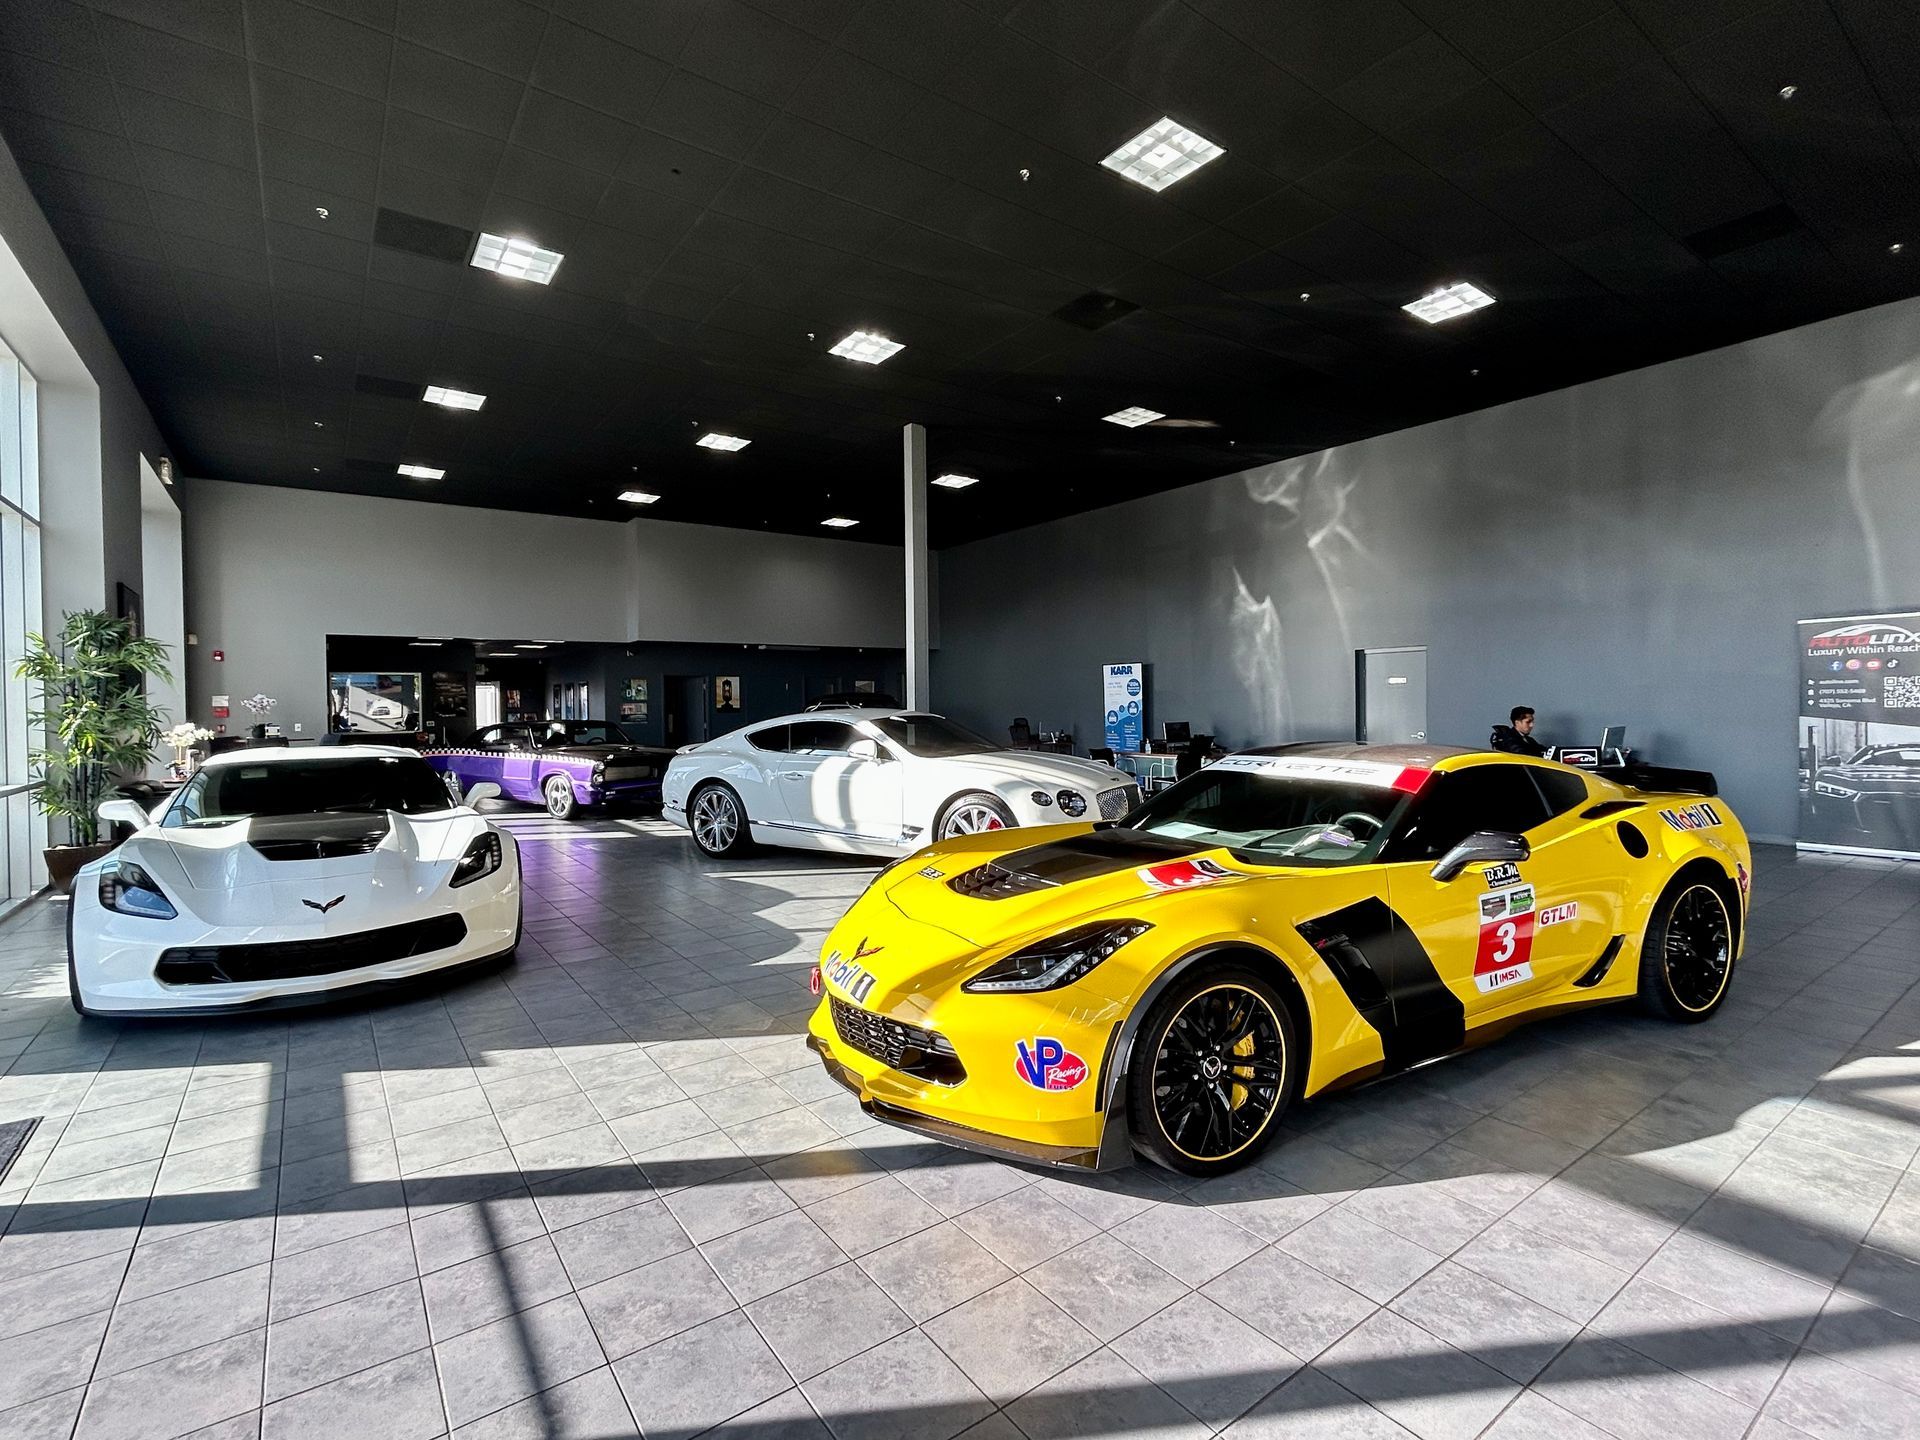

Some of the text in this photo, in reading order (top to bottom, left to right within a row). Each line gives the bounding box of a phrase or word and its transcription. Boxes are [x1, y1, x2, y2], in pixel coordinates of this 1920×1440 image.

[1808, 648, 1844, 656] Luxury
[1846, 645, 1884, 654] Within
[1110, 665, 1132, 675] KARR
[1219, 758, 1379, 776] CORVETTE
[1659, 804, 1721, 832] Mobil 1
[1541, 903, 1577, 925] GTLM
[1493, 922, 1517, 963] 3
[825, 950, 874, 1001] Mobil 1
[1016, 1038, 1063, 1089] VP
[1048, 1066, 1086, 1084] Racing
